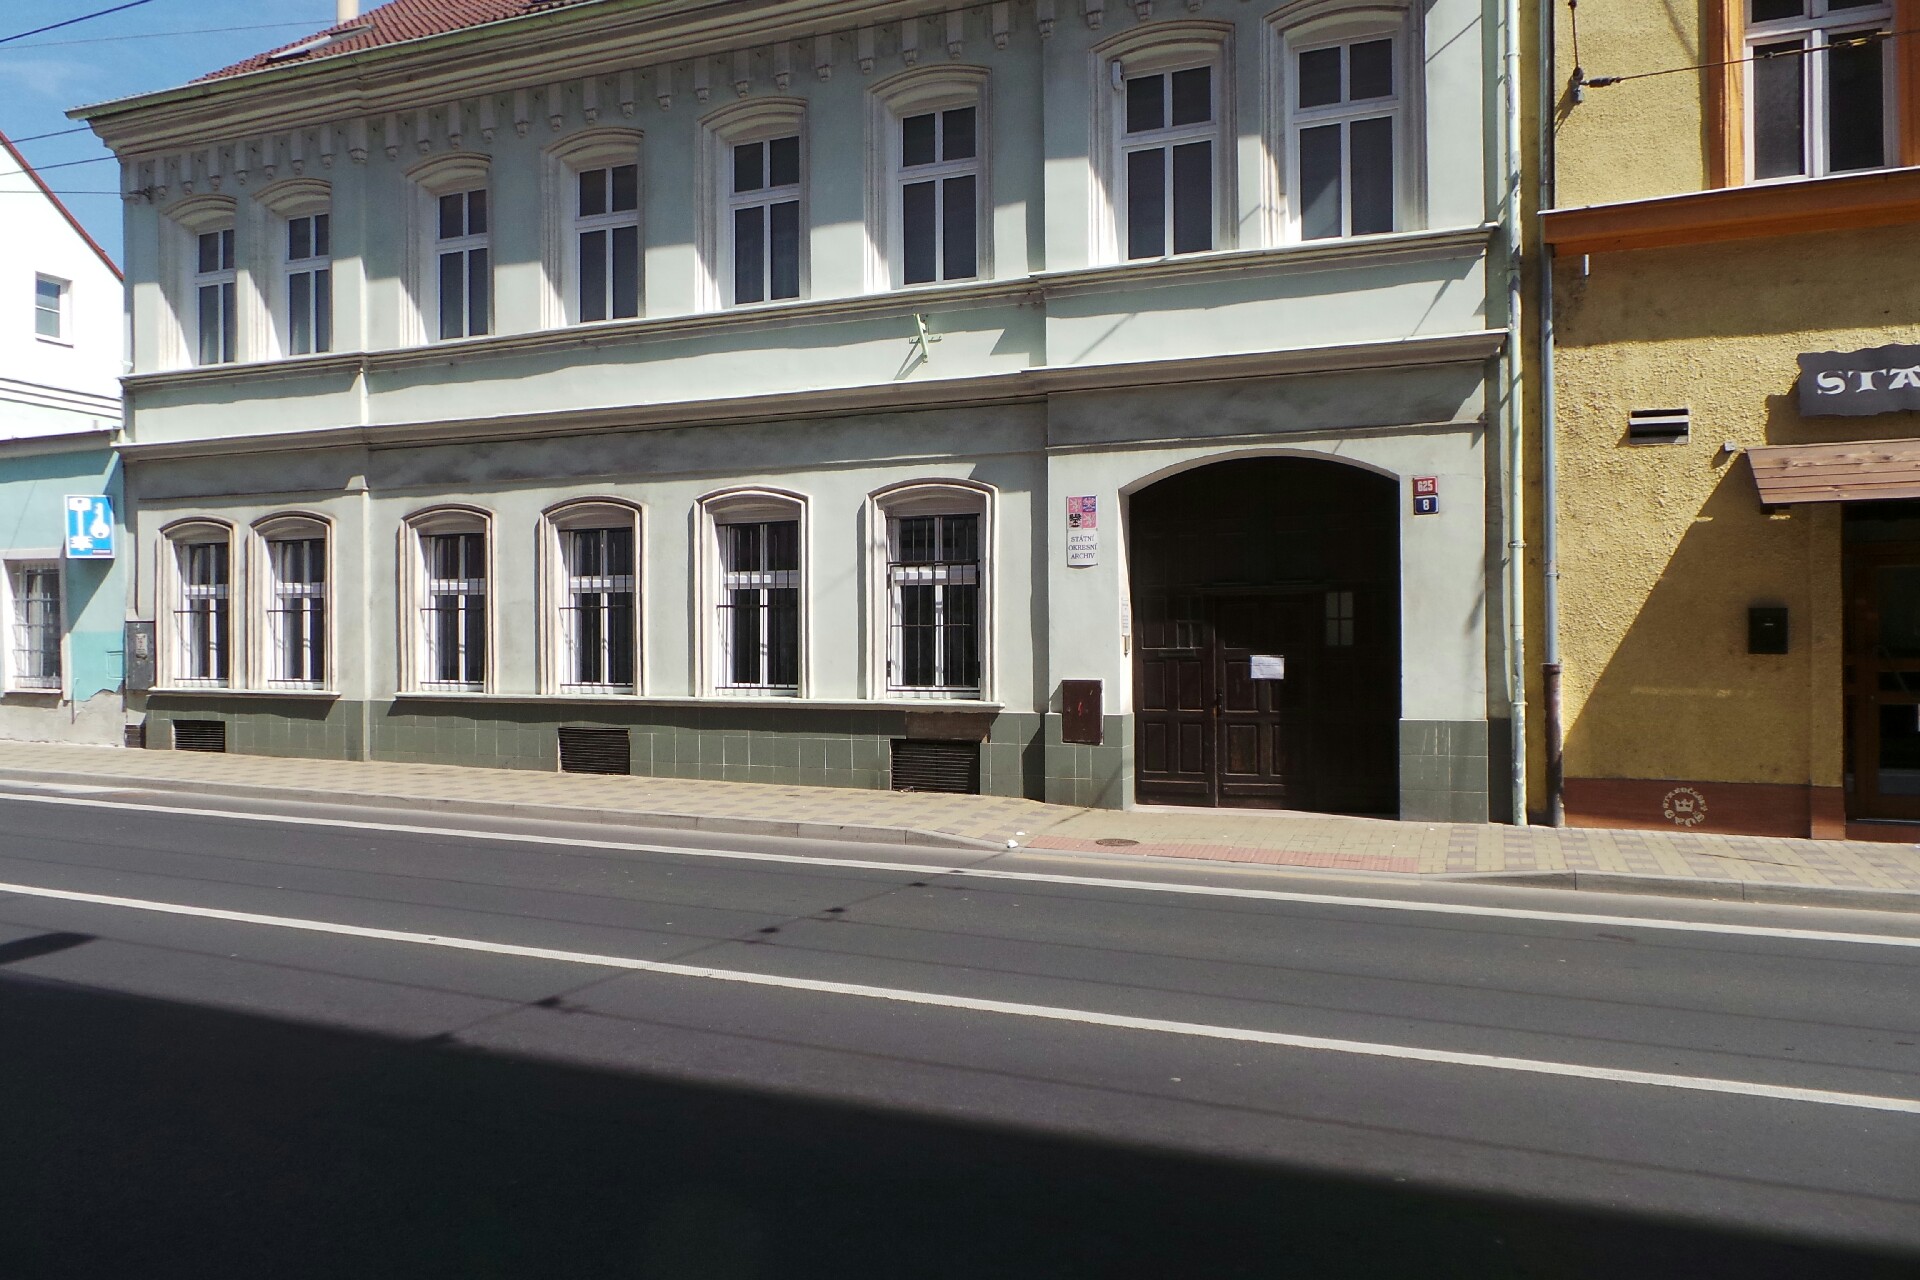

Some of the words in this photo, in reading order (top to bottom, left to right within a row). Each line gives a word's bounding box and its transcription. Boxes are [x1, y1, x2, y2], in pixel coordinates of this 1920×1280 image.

[1817, 365, 1920, 394] STA
[1417, 480, 1433, 492] 625
[1422, 499, 1430, 511] 8
[1070, 534, 1095, 543] STÁTNÍ
[1068, 543, 1098, 551] OKRESNÍ
[1070, 552, 1096, 560] ARCHIV
